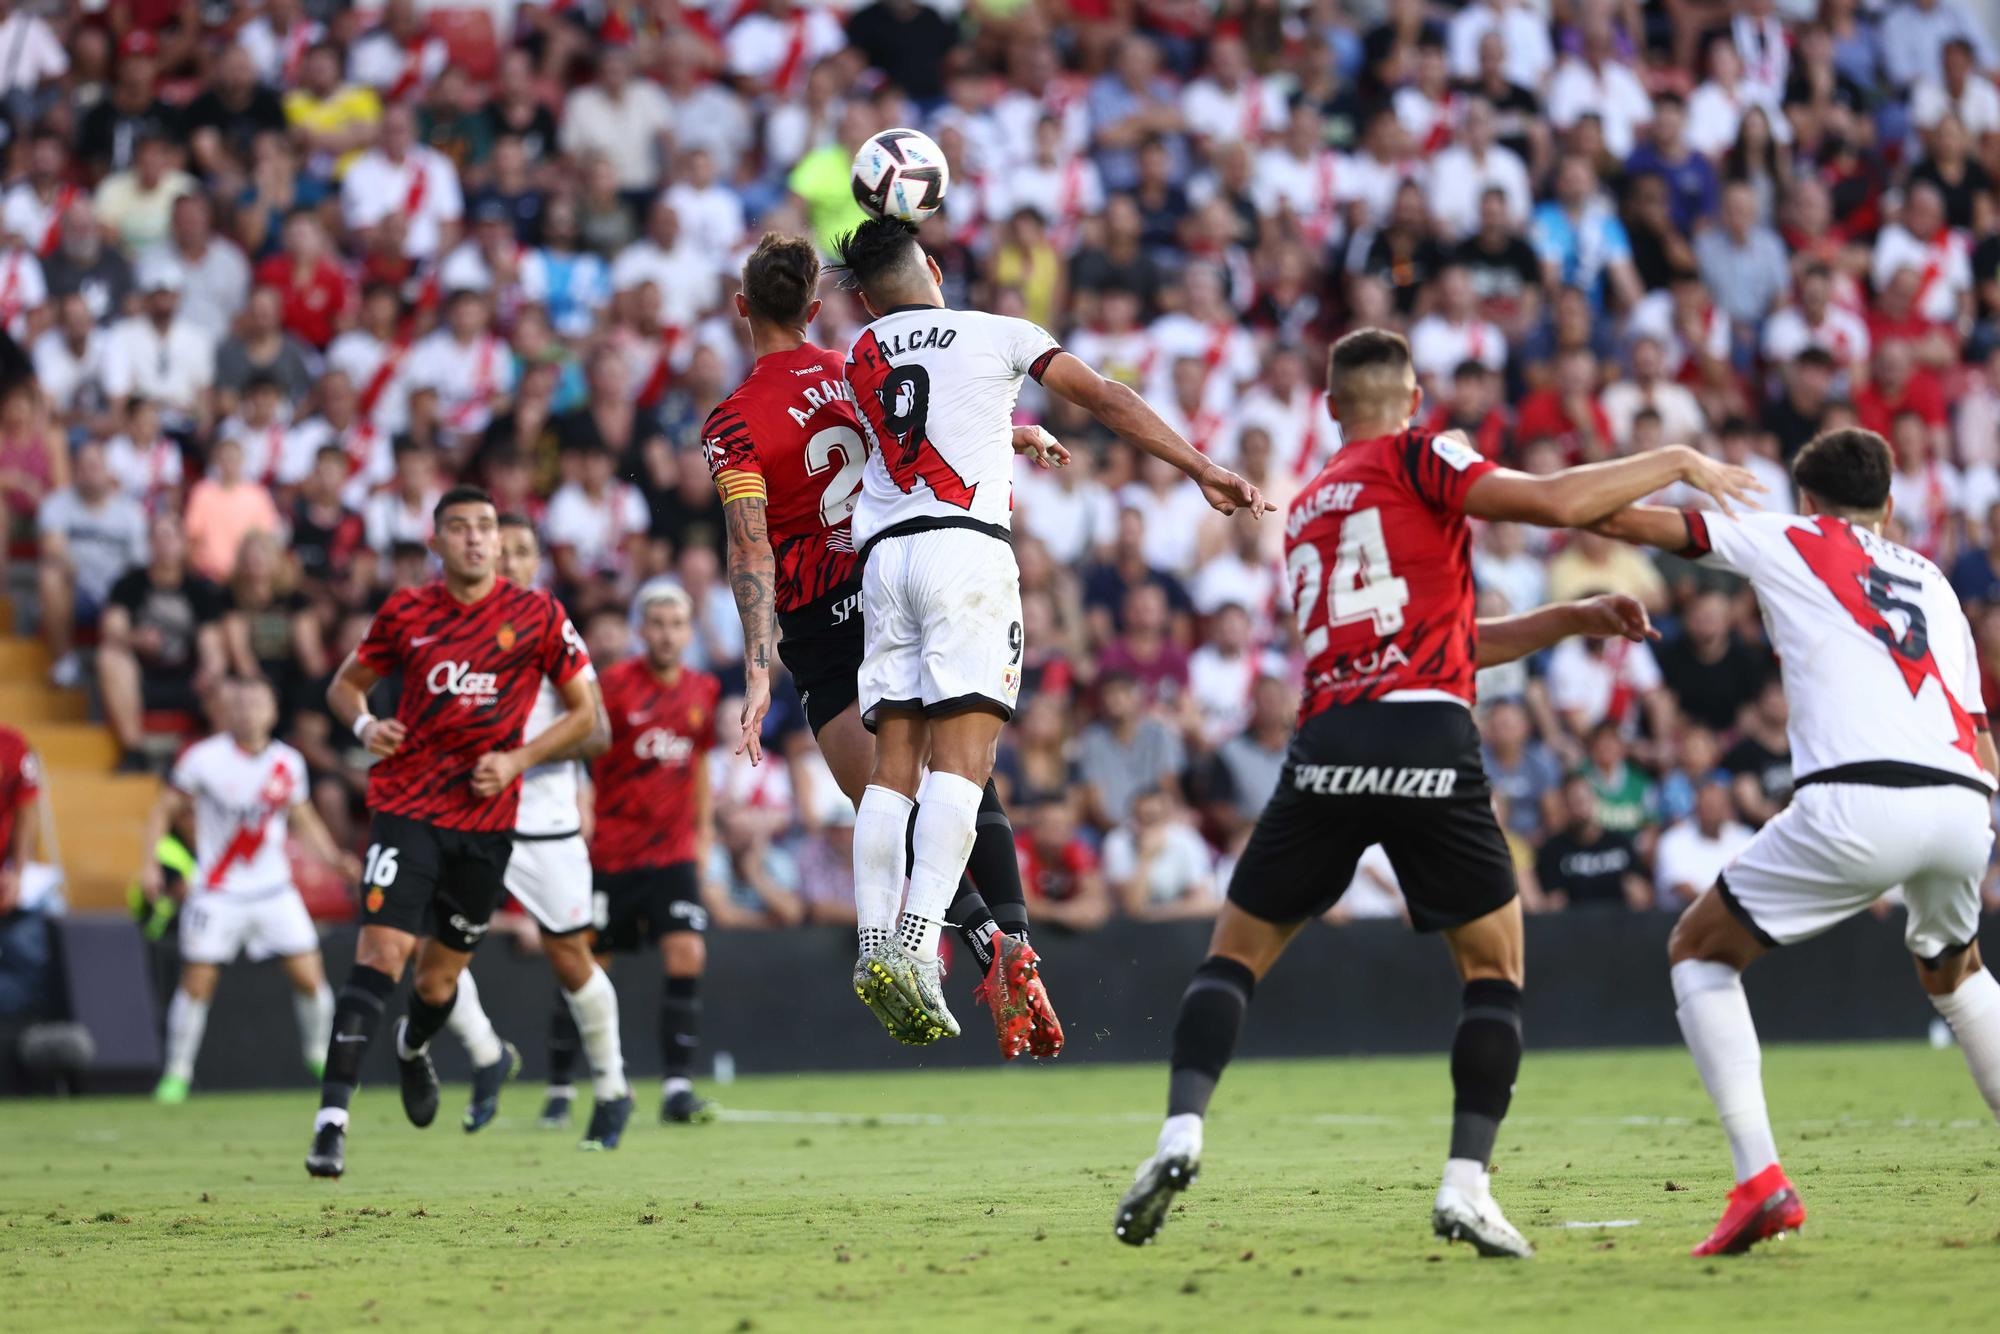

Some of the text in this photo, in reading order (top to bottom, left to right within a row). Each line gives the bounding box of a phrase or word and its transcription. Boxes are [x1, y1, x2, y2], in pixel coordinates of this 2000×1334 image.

[864, 327, 957, 369] FALCAO
[879, 364, 930, 465] 9
[1288, 506, 1410, 660] 24
[1868, 567, 1928, 661] 5
[1008, 621, 1022, 665] 9
[1294, 764, 1457, 798] SPECIALIZED
[364, 843, 399, 887] 16
